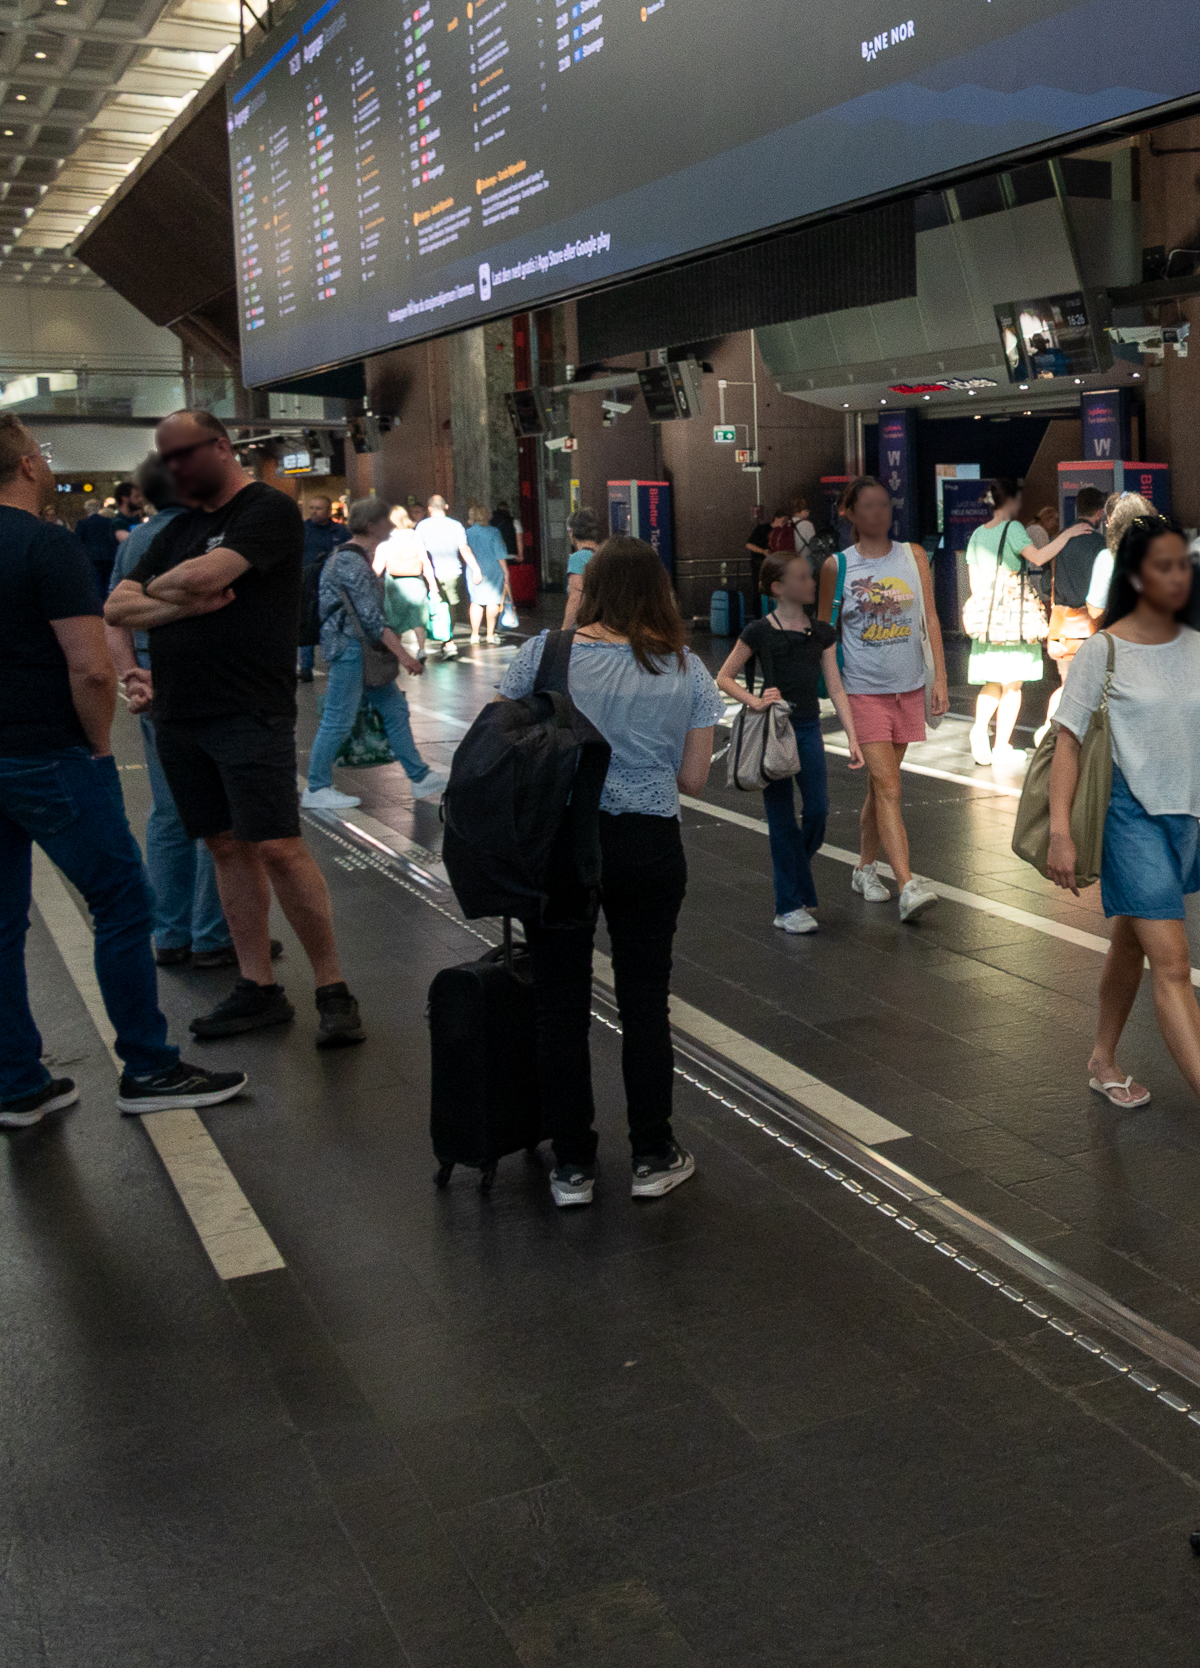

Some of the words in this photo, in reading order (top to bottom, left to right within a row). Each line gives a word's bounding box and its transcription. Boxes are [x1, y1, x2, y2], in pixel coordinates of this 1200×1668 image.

[890, 20, 915, 46] NOR
[576, 235, 597, 257] Google
[862, 623, 911, 641] Aloha
